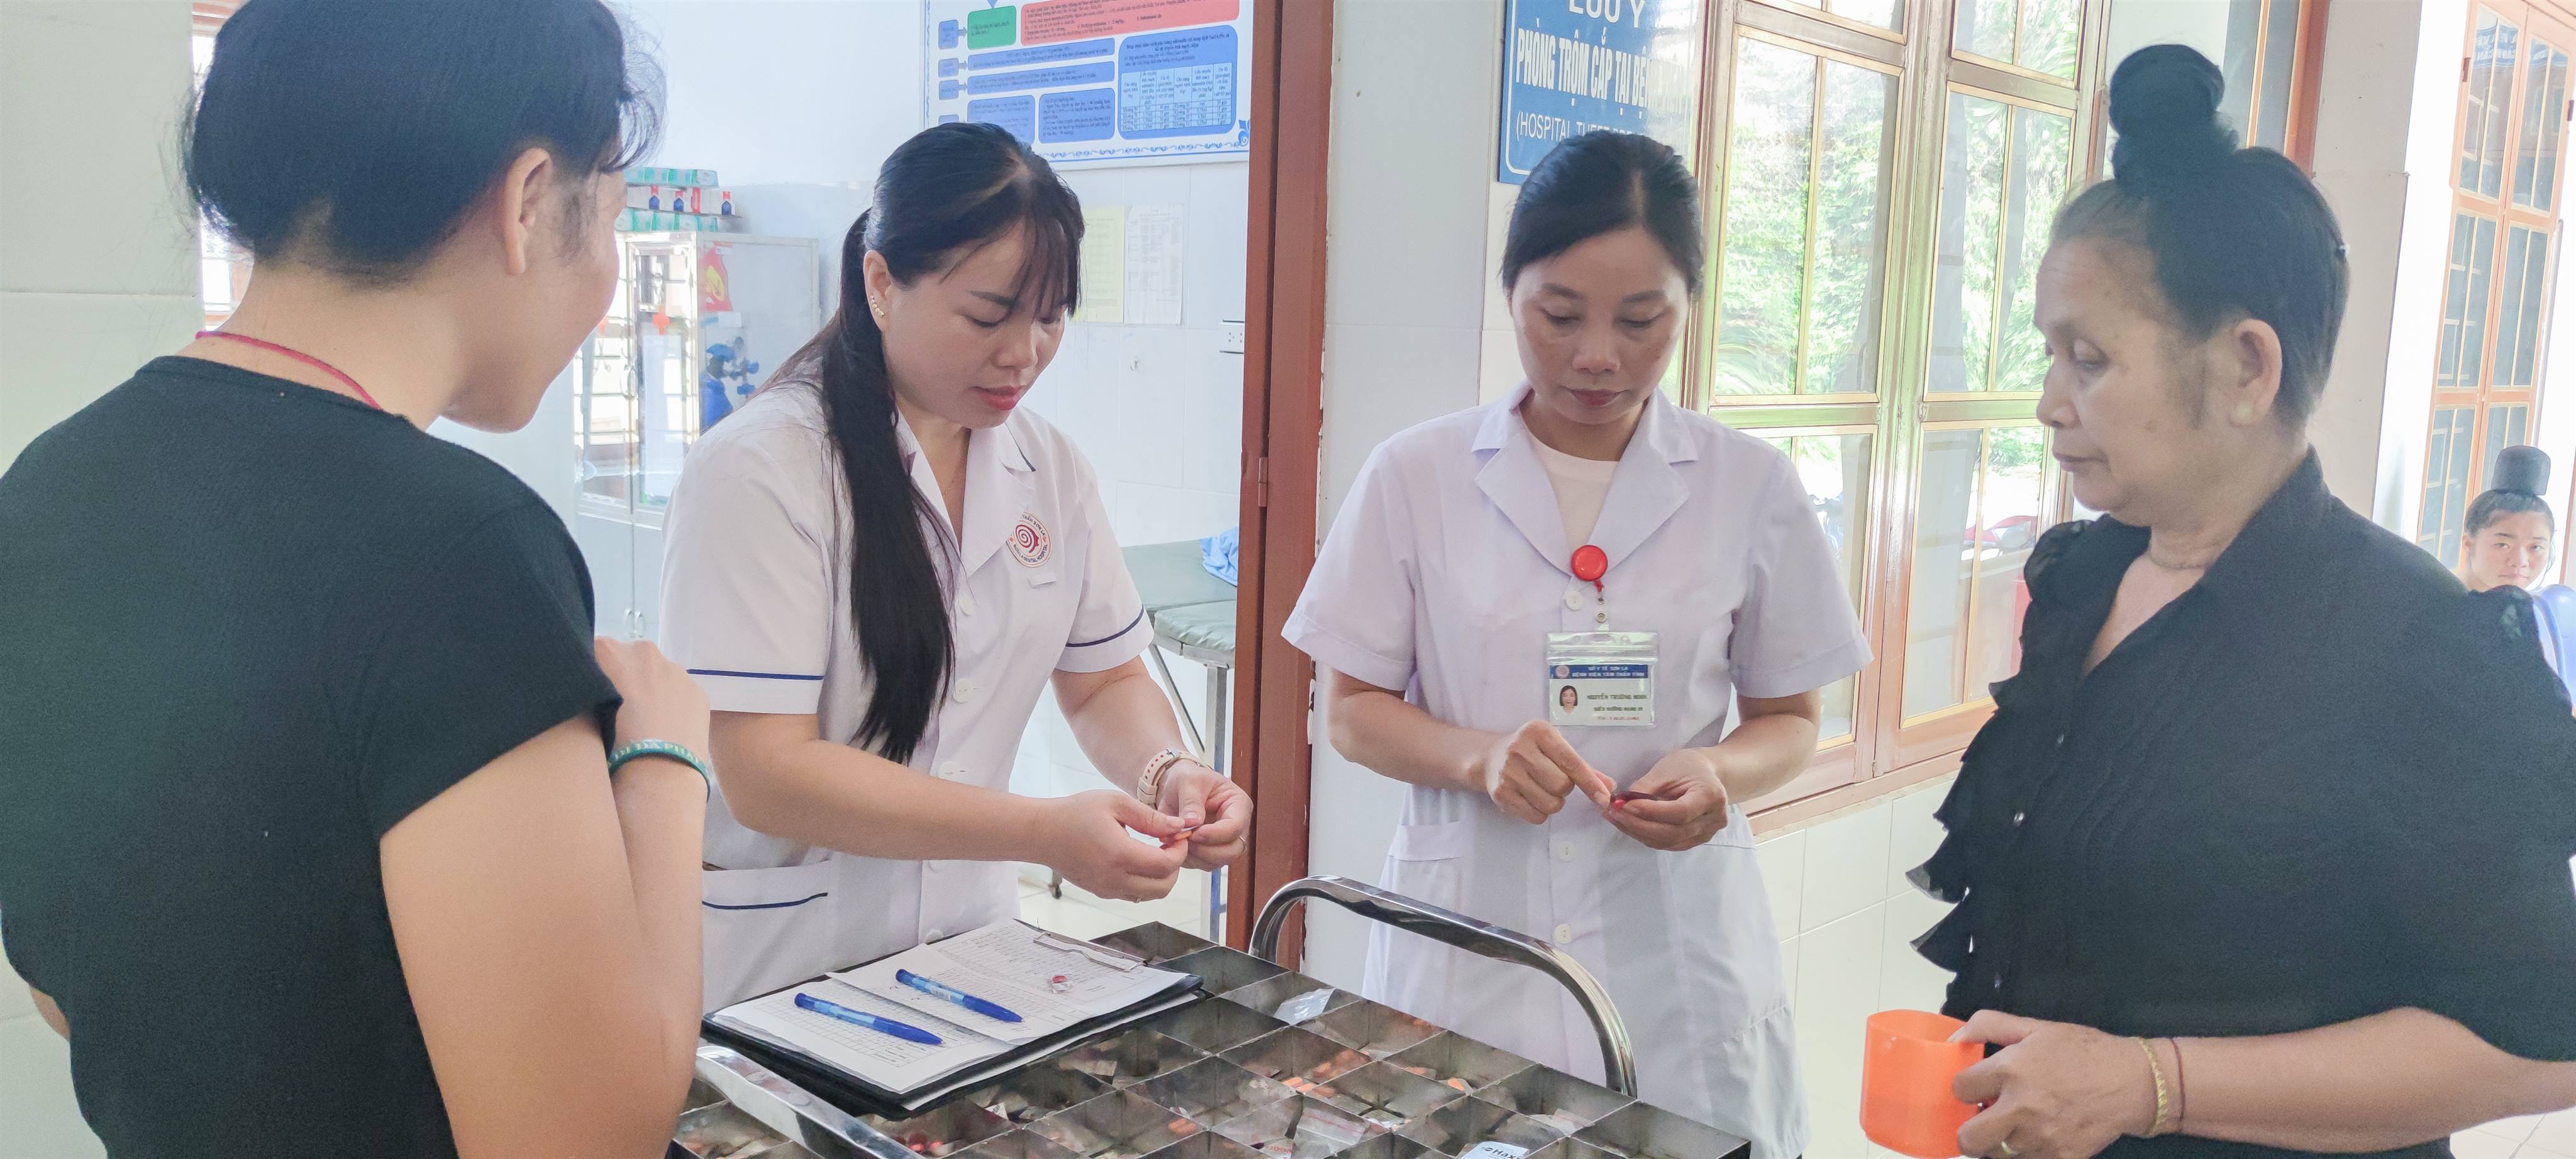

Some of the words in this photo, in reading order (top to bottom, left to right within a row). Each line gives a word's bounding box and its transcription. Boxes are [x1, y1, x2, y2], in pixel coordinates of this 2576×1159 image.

[1516, 18, 1556, 90] PHÒNG
[1558, 29, 1589, 106] TRỘM
[1591, 26, 1613, 100] CẮP
[1614, 50, 1631, 116] TẠI
[1492, 1149, 1520, 1159] Hax
